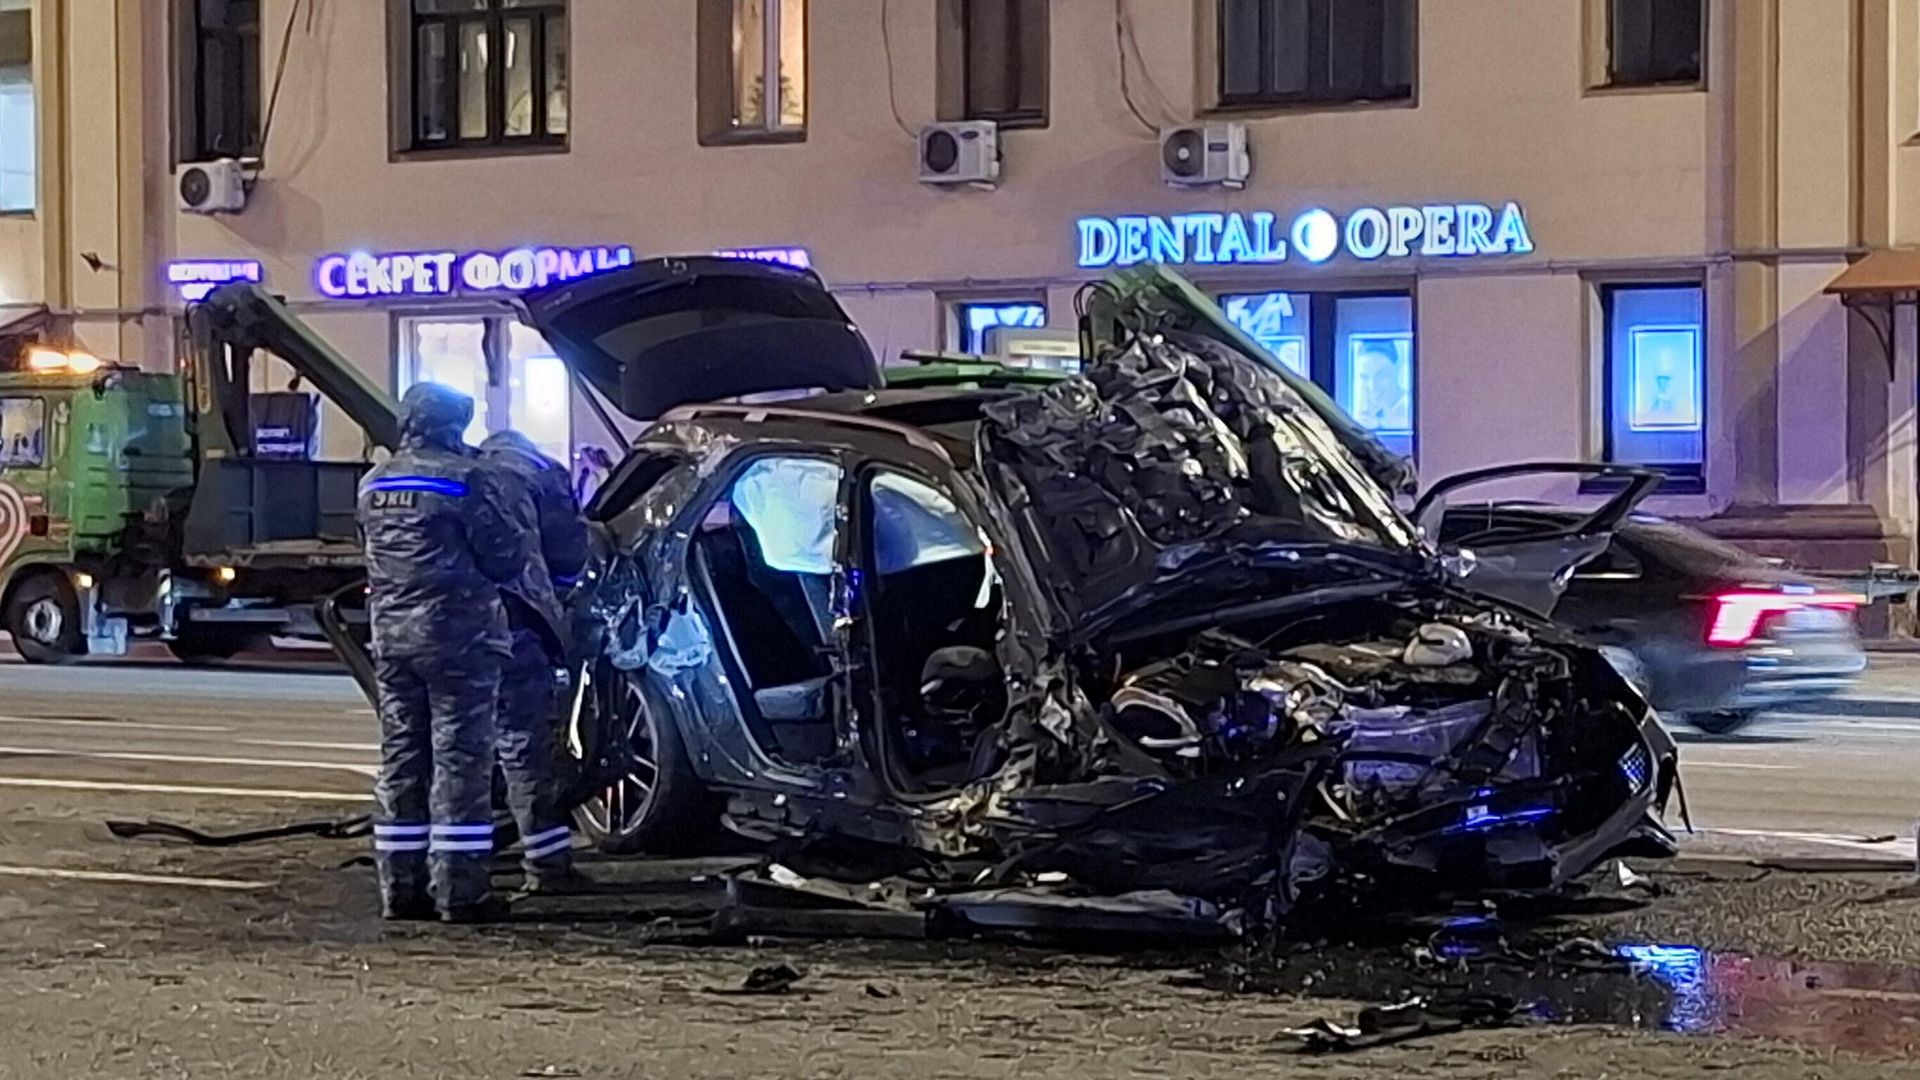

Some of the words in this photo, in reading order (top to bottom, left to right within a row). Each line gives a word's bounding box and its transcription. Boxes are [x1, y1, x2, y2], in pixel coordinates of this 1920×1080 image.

[1078, 212, 1287, 266] DENTAL
[1345, 202, 1534, 259] OPERA
[318, 252, 456, 296] СЕКРЕТ
